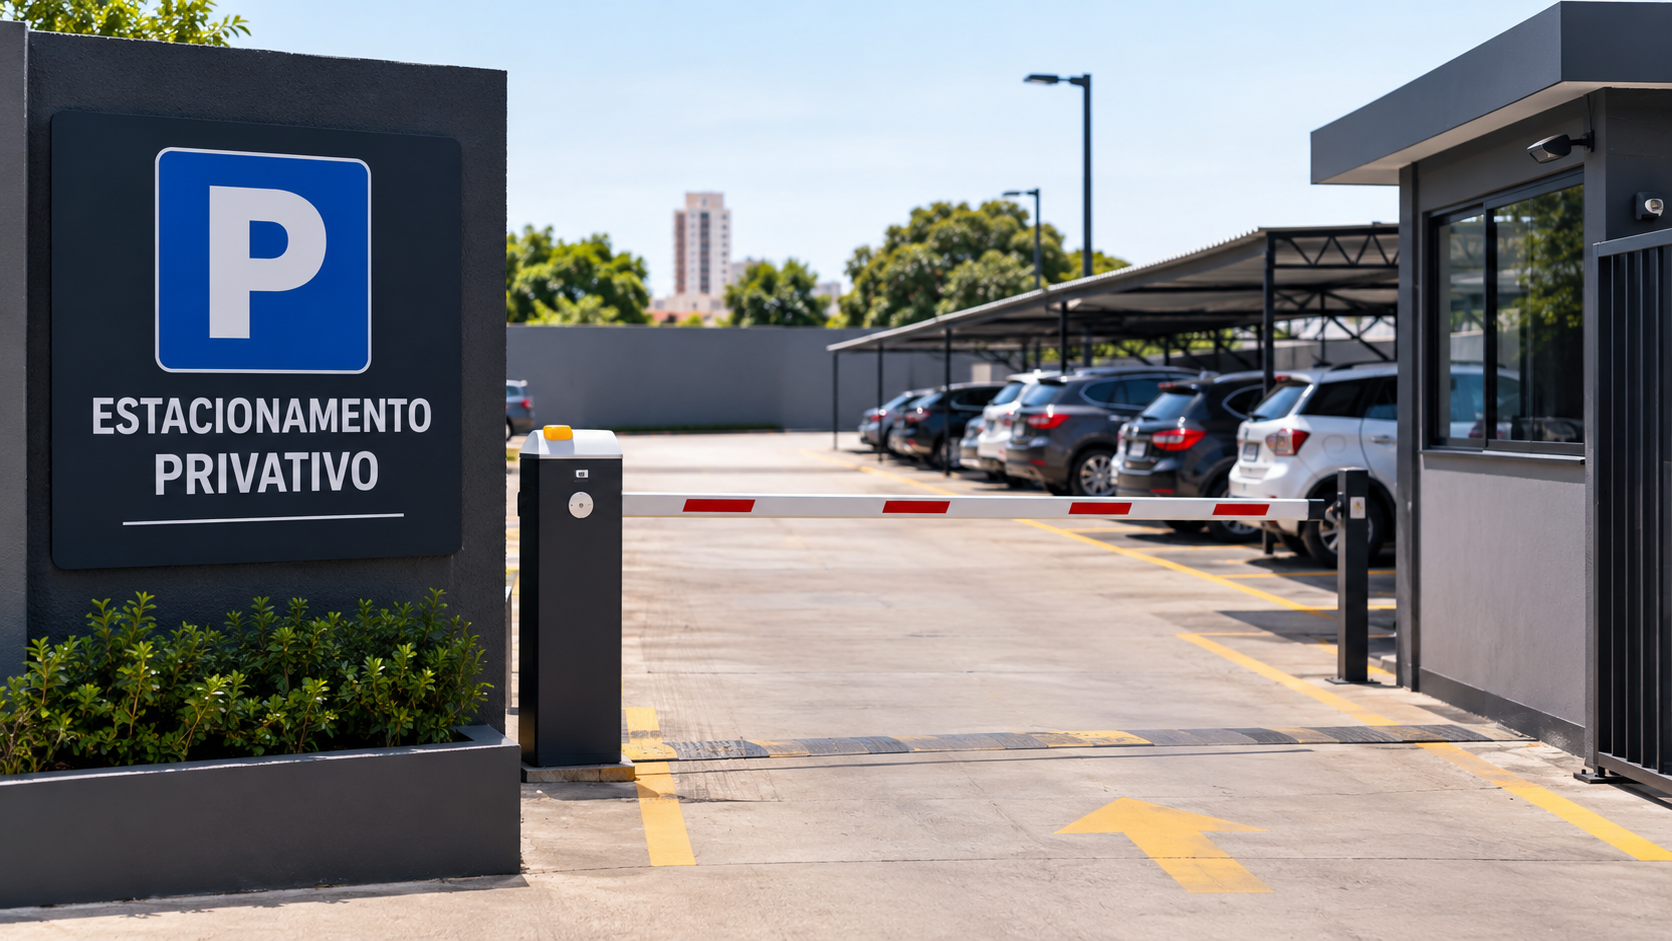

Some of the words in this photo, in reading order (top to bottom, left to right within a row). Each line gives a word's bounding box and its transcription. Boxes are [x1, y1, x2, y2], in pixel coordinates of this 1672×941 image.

[208, 185, 327, 340] P
[92, 396, 432, 435] ESTACIONAMENTO
[155, 449, 379, 496] PRIVATIVO
